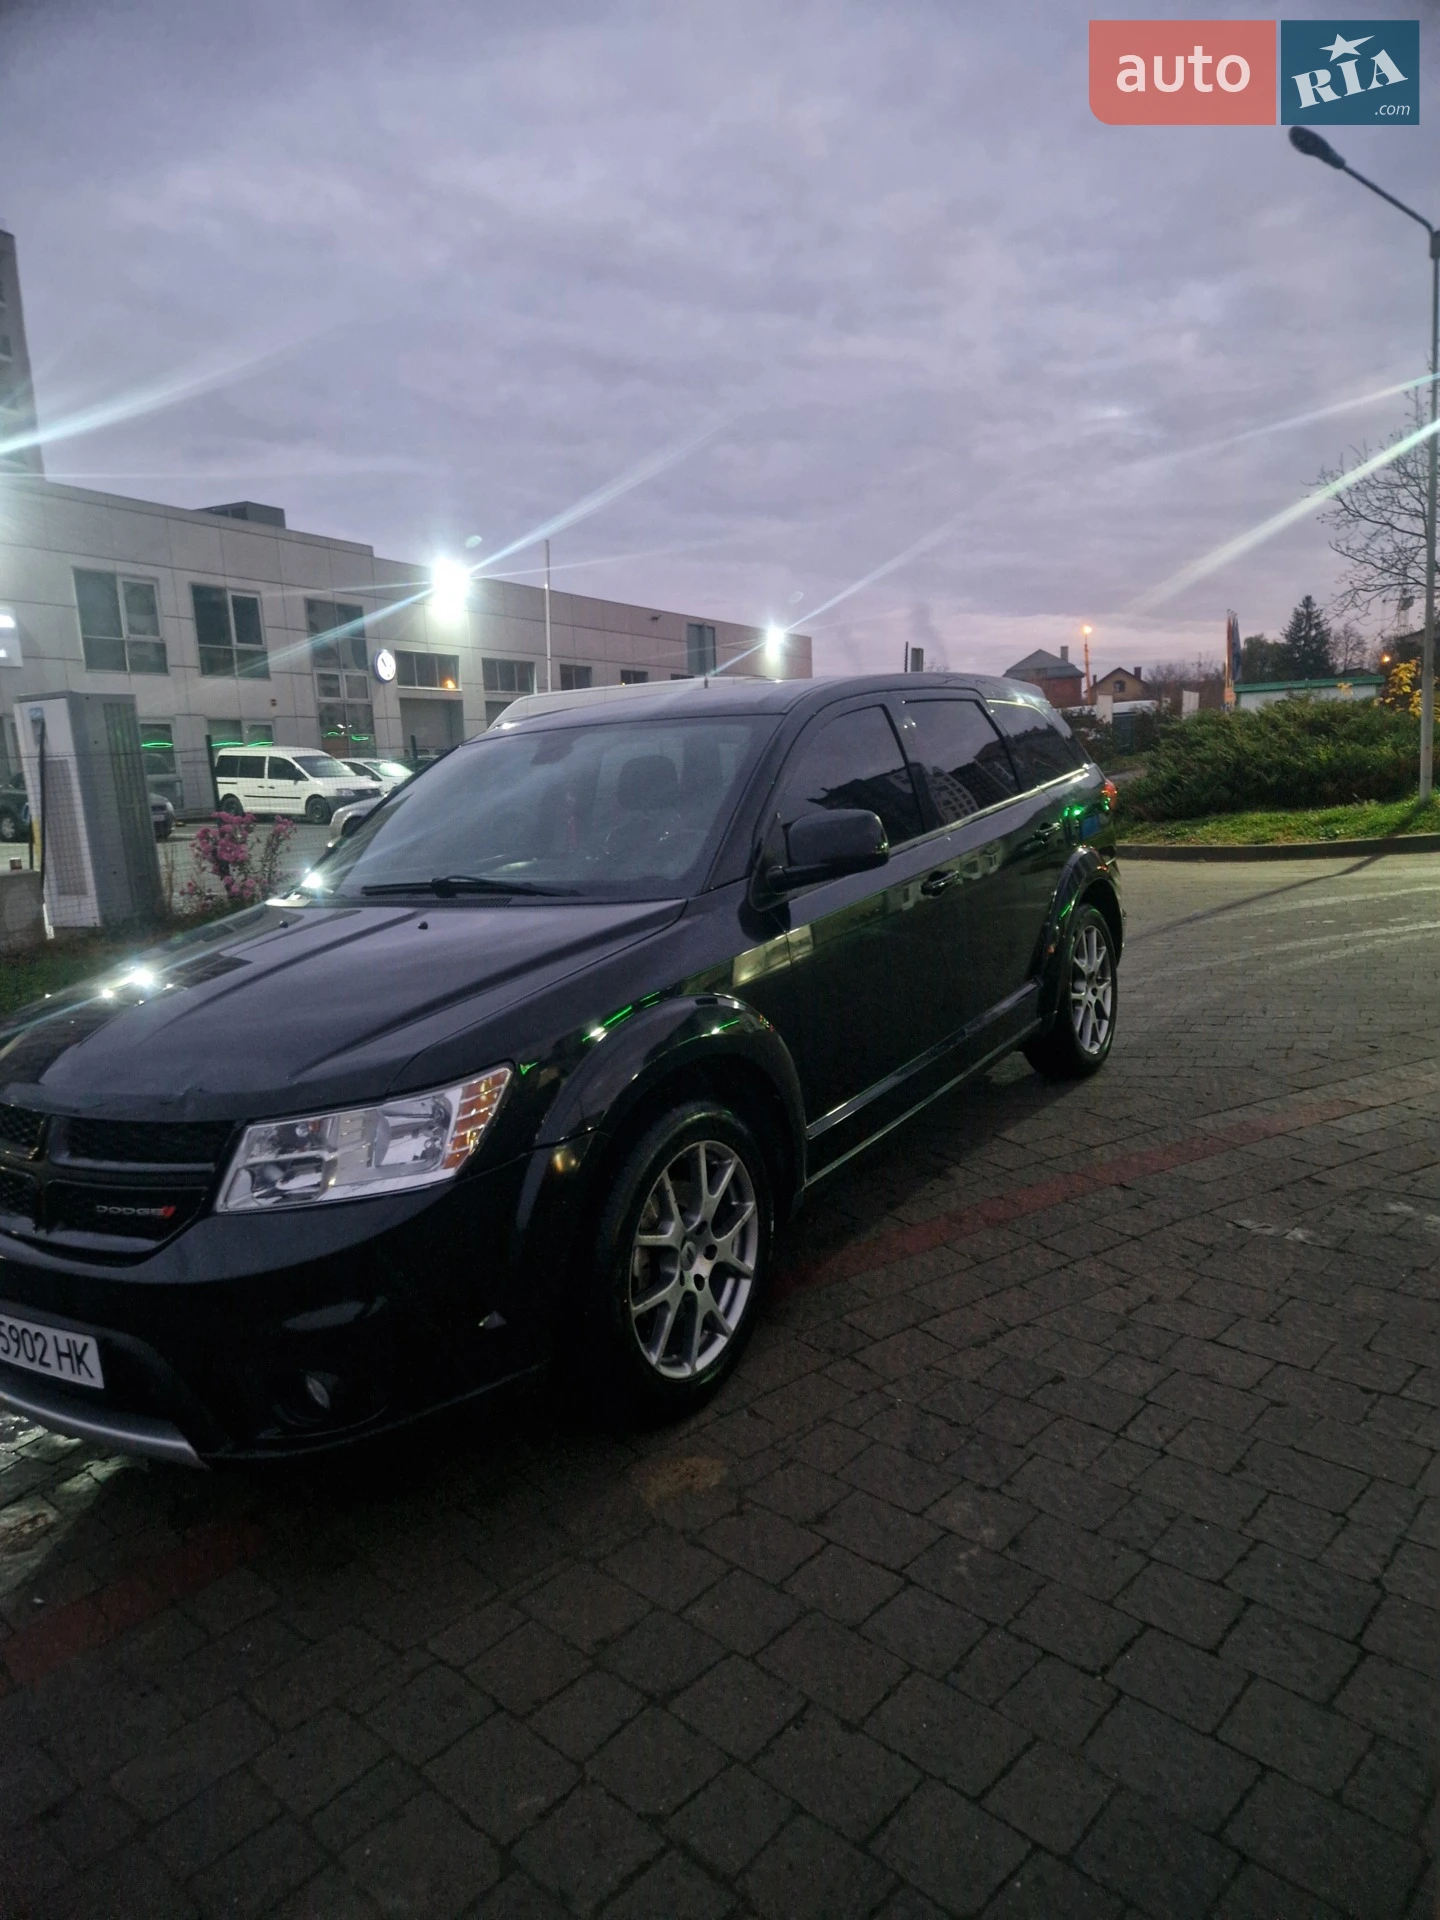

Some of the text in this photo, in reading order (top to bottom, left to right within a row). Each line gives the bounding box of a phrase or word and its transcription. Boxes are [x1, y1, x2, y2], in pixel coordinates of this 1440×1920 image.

[96, 1205, 164, 1216] DODGE
[0, 1321, 95, 1379] 5902 HK
